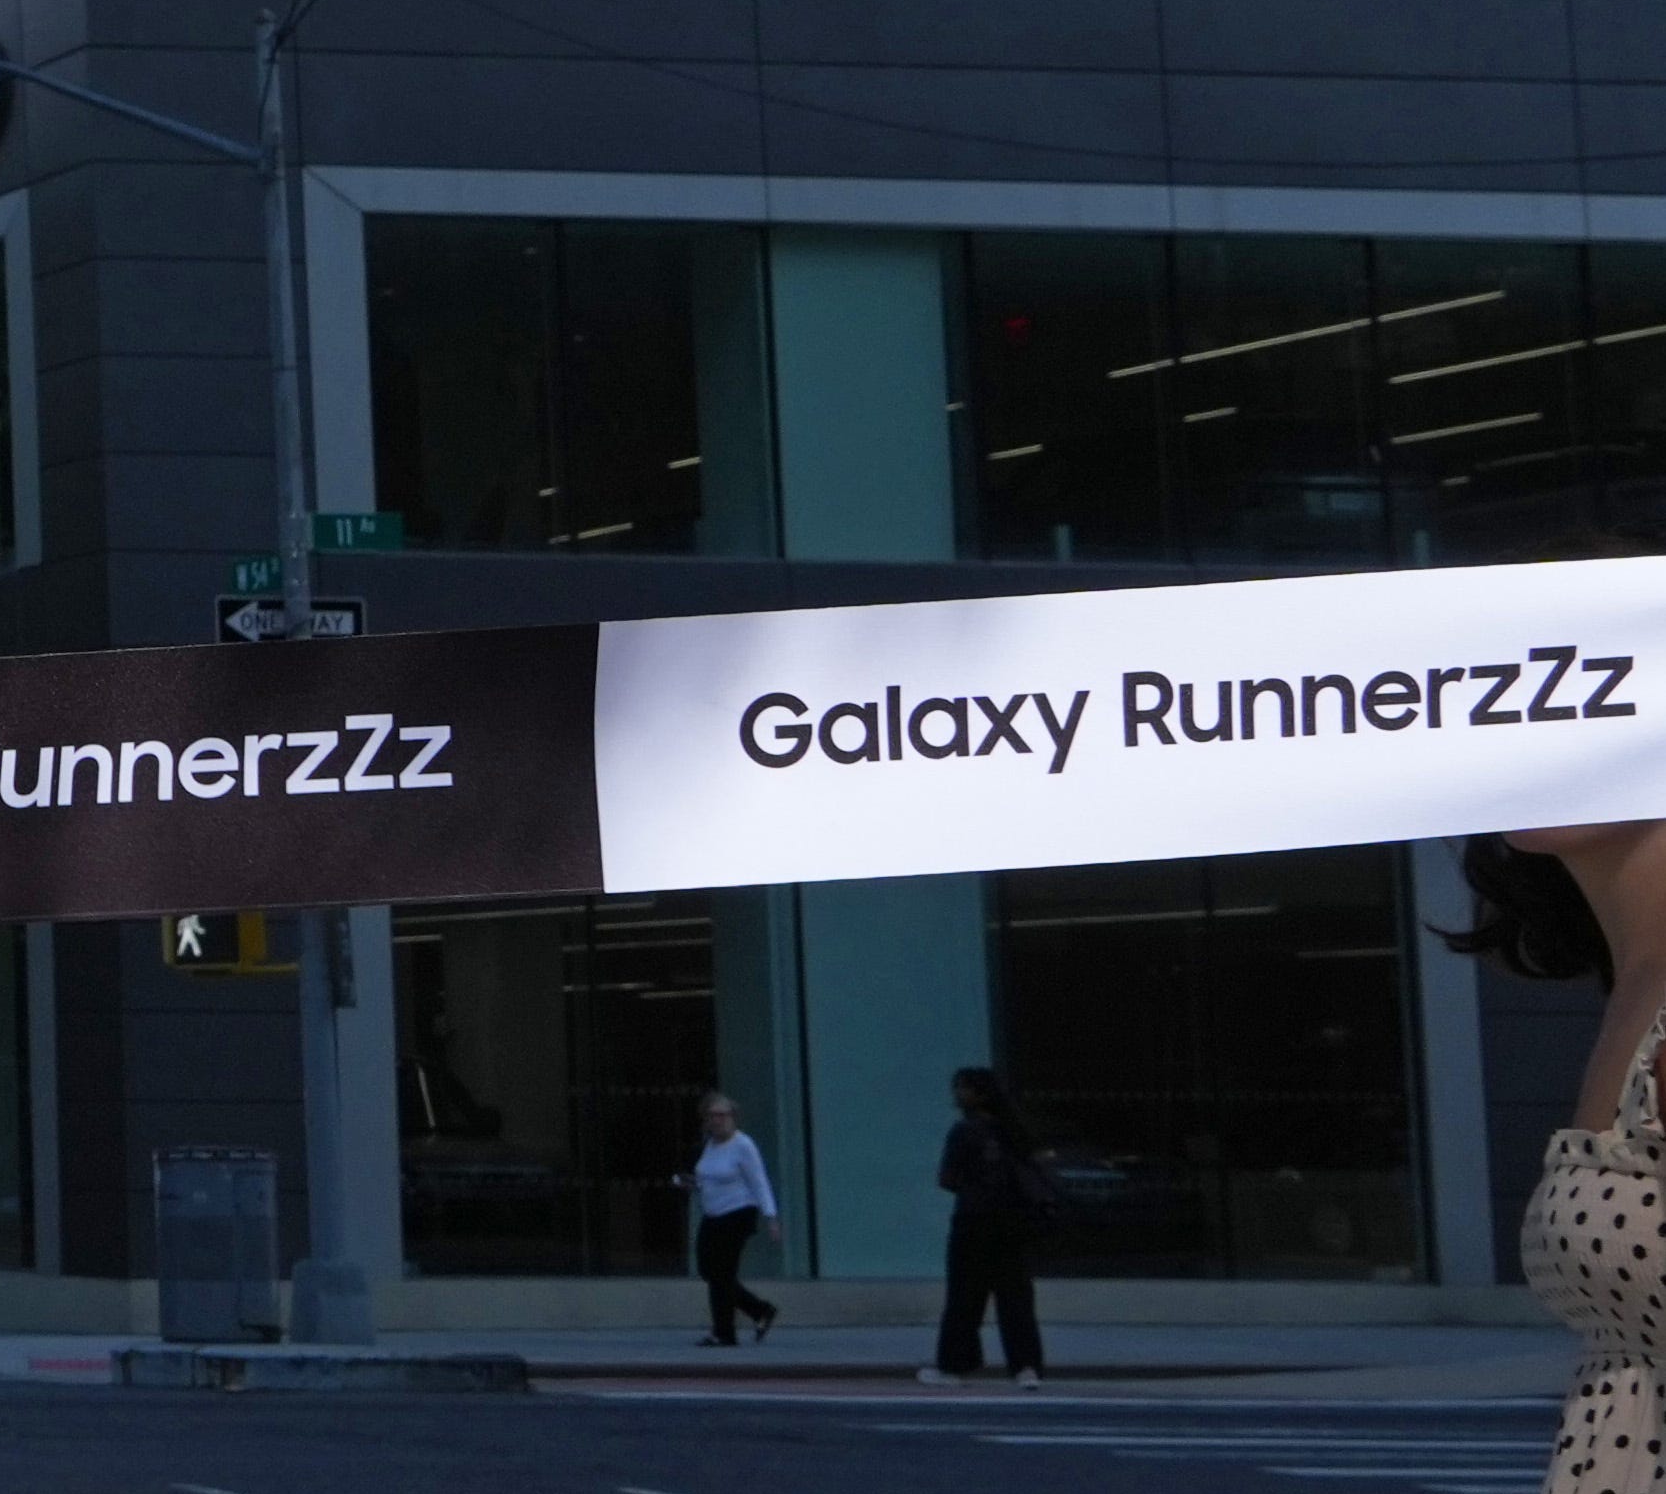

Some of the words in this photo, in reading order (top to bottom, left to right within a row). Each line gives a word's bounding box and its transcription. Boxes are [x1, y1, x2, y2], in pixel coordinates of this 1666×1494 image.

[336, 518, 353, 547] 11
[739, 686, 1090, 774] Galaxy
[1122, 645, 1636, 747] RunnerzZz
